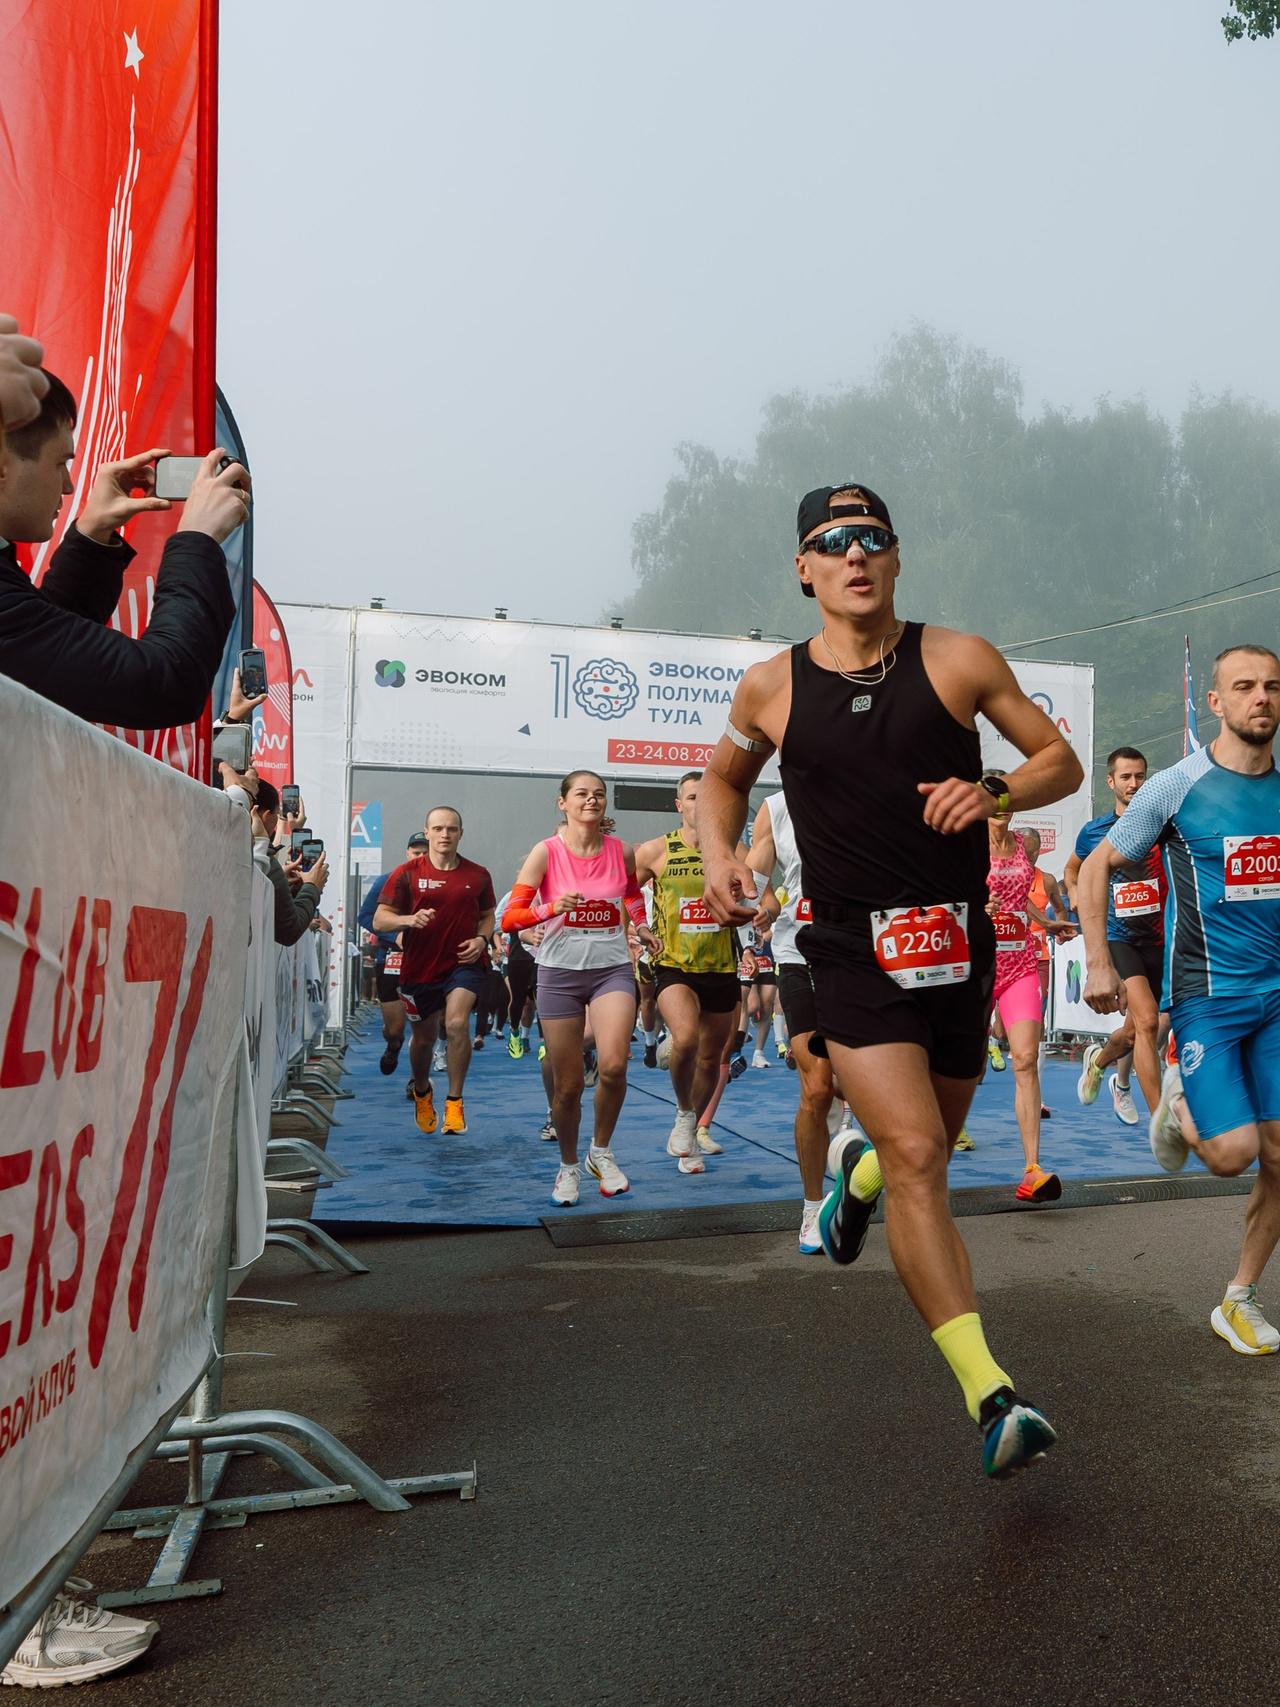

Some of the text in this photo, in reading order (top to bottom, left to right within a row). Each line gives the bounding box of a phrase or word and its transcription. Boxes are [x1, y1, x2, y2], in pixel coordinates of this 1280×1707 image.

[415, 669, 506, 688] ЭВОКОМ
[648, 662, 745, 682] ЭВОКОМ
[430, 686, 506, 697] эволюция комфорта
[647, 708, 703, 726] ТУЛА
[668, 867, 689, 876] JUST
[1124, 891, 1149, 903] 2265
[578, 910, 611, 922] 2008
[900, 929, 951, 955] 2264
[35, 1347, 77, 1420] КЛУБ
